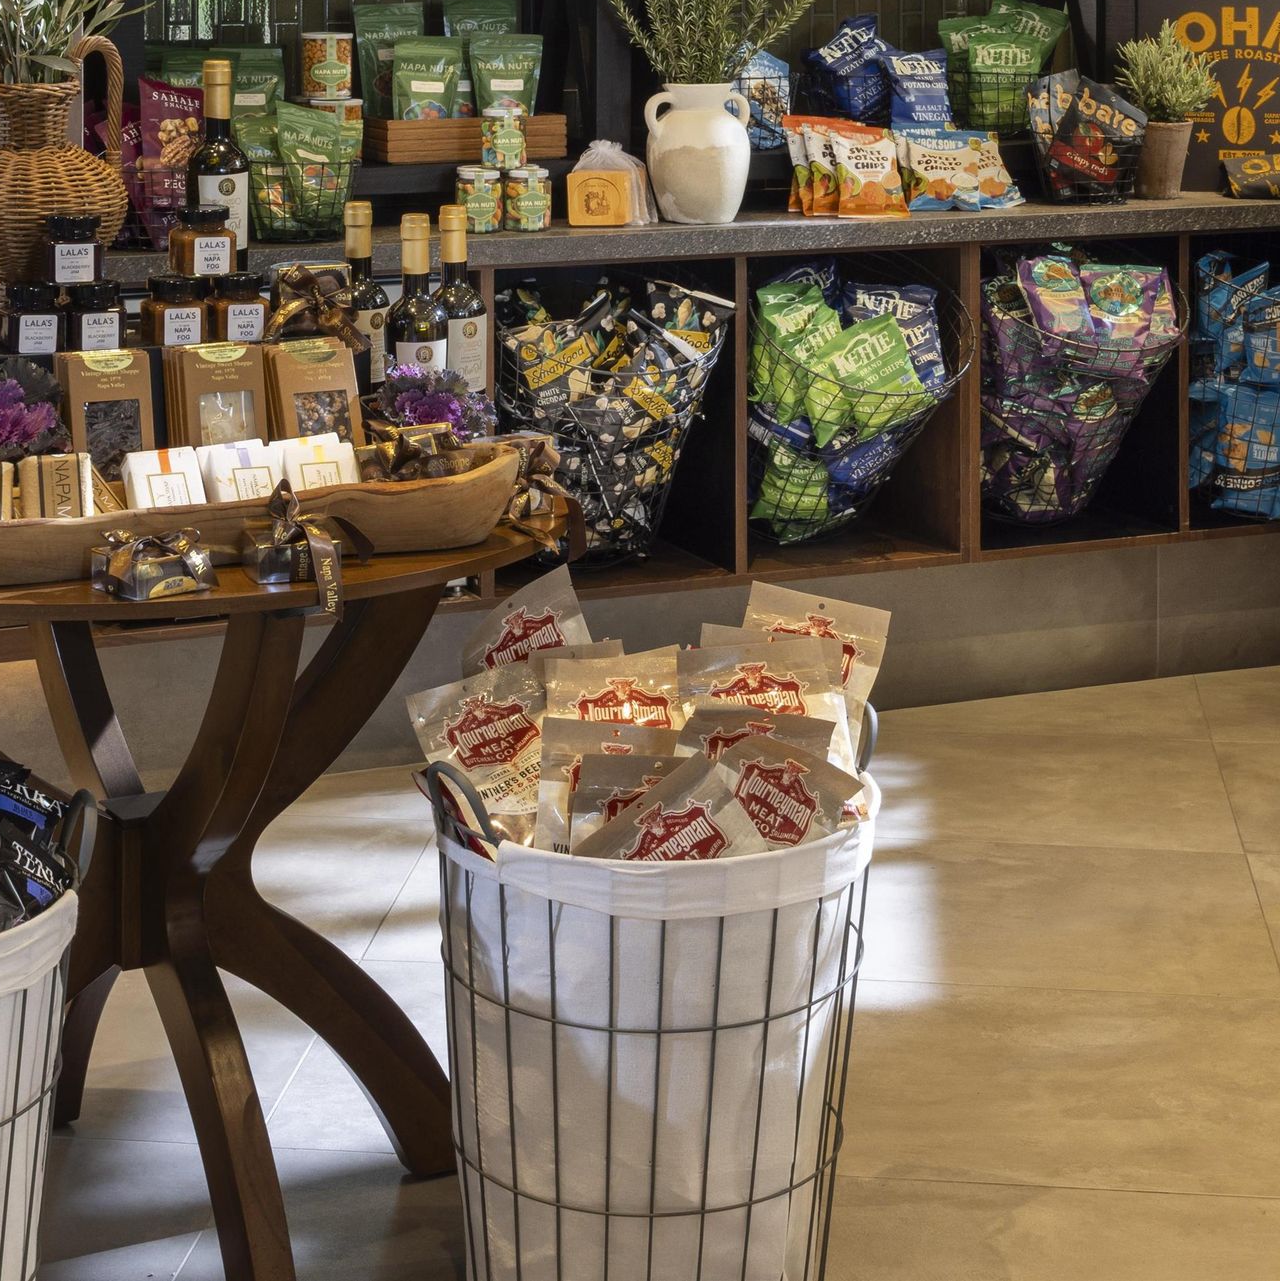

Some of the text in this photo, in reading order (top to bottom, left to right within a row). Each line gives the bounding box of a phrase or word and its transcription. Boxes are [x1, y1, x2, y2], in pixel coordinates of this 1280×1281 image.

[819, 25, 877, 64] KETTLE
[974, 43, 1035, 66] KETTLE
[401, 63, 426, 72] NAPA
[478, 61, 534, 70] NAPA NUTS
[889, 54, 946, 76] KETTLE
[152, 91, 201, 109] SAHALE
[164, 101, 194, 112] SNACKS
[1078, 87, 1137, 136] bare
[283, 130, 334, 150] NAPA NUTS
[915, 138, 963, 150] JACKSON'S
[849, 146, 882, 155] SWEET
[847, 153, 888, 162] POTATO
[917, 158, 962, 167] POTATO
[920, 153, 958, 161] SWEET
[1066, 150, 1090, 168] crispy
[855, 161, 886, 170] CHIPS
[199, 241, 226, 249] LALA'S
[60, 248, 89, 256] LALA'S
[856, 289, 921, 320] KETTLE
[169, 311, 196, 320] LALA'S
[232, 308, 259, 317] LALA'S
[24, 319, 53, 327] LALA'S
[87, 317, 114, 326] LALA'S
[832, 331, 896, 378] KETTLE
[531, 345, 585, 385] Smartfood
[880, 360, 905, 376] CHIPS
[538, 387, 560, 398] WHITE
[537, 394, 568, 407] CHEDDAR
[320, 557, 339, 614] Napa Valley
[454, 713, 531, 758] Journeyman
[480, 736, 515, 756] MEAT
[496, 749, 514, 760] CO
[739, 768, 812, 831] Journeyman
[749, 801, 784, 827] MEAT
